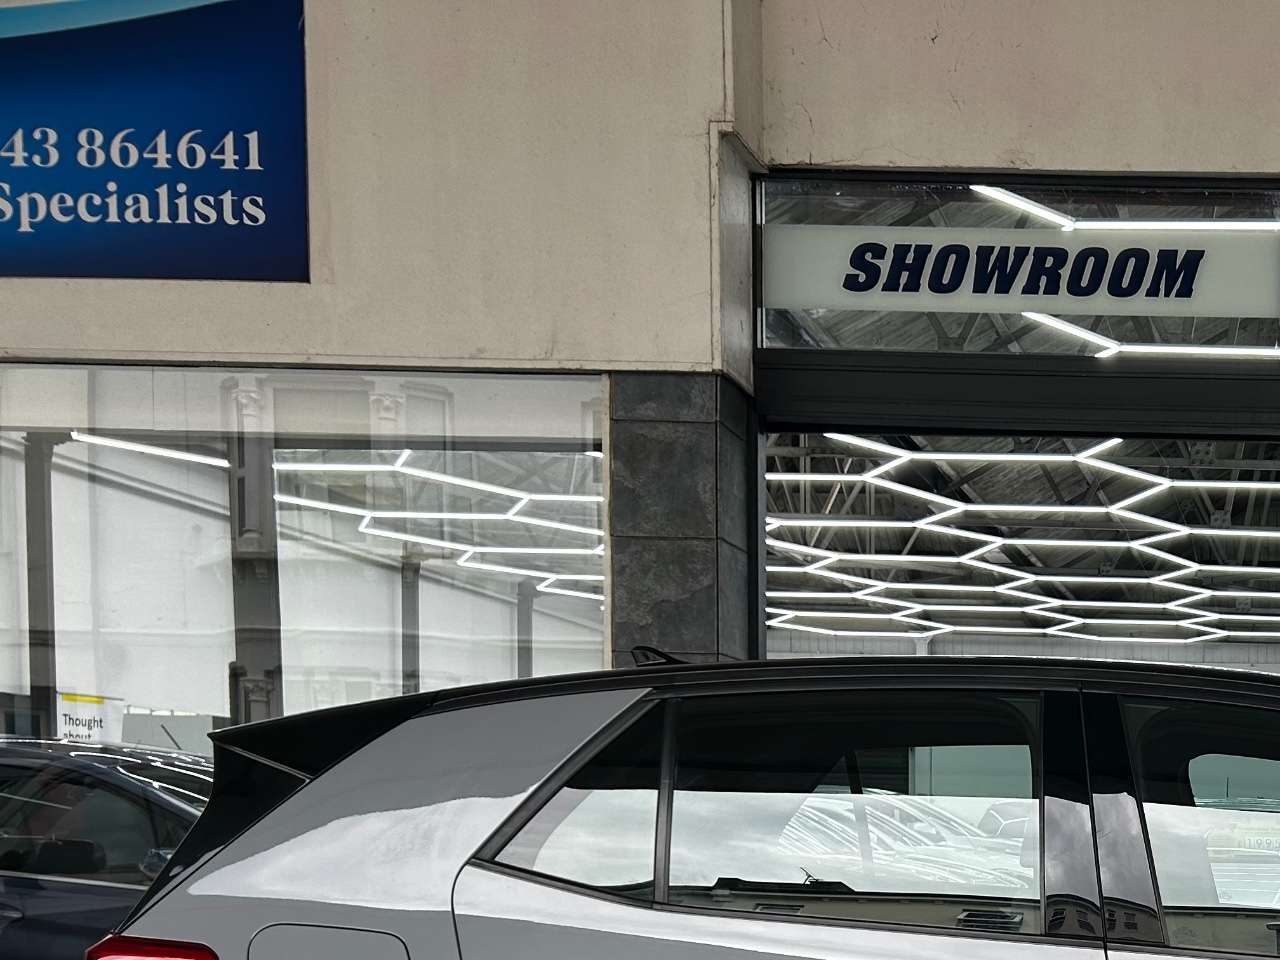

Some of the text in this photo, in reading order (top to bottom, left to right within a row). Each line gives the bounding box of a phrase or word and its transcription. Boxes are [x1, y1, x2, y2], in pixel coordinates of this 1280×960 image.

[77, 128, 264, 171] 864641
[842, 242, 1205, 299] SHOWROOM
[62, 713, 104, 730] Thought
